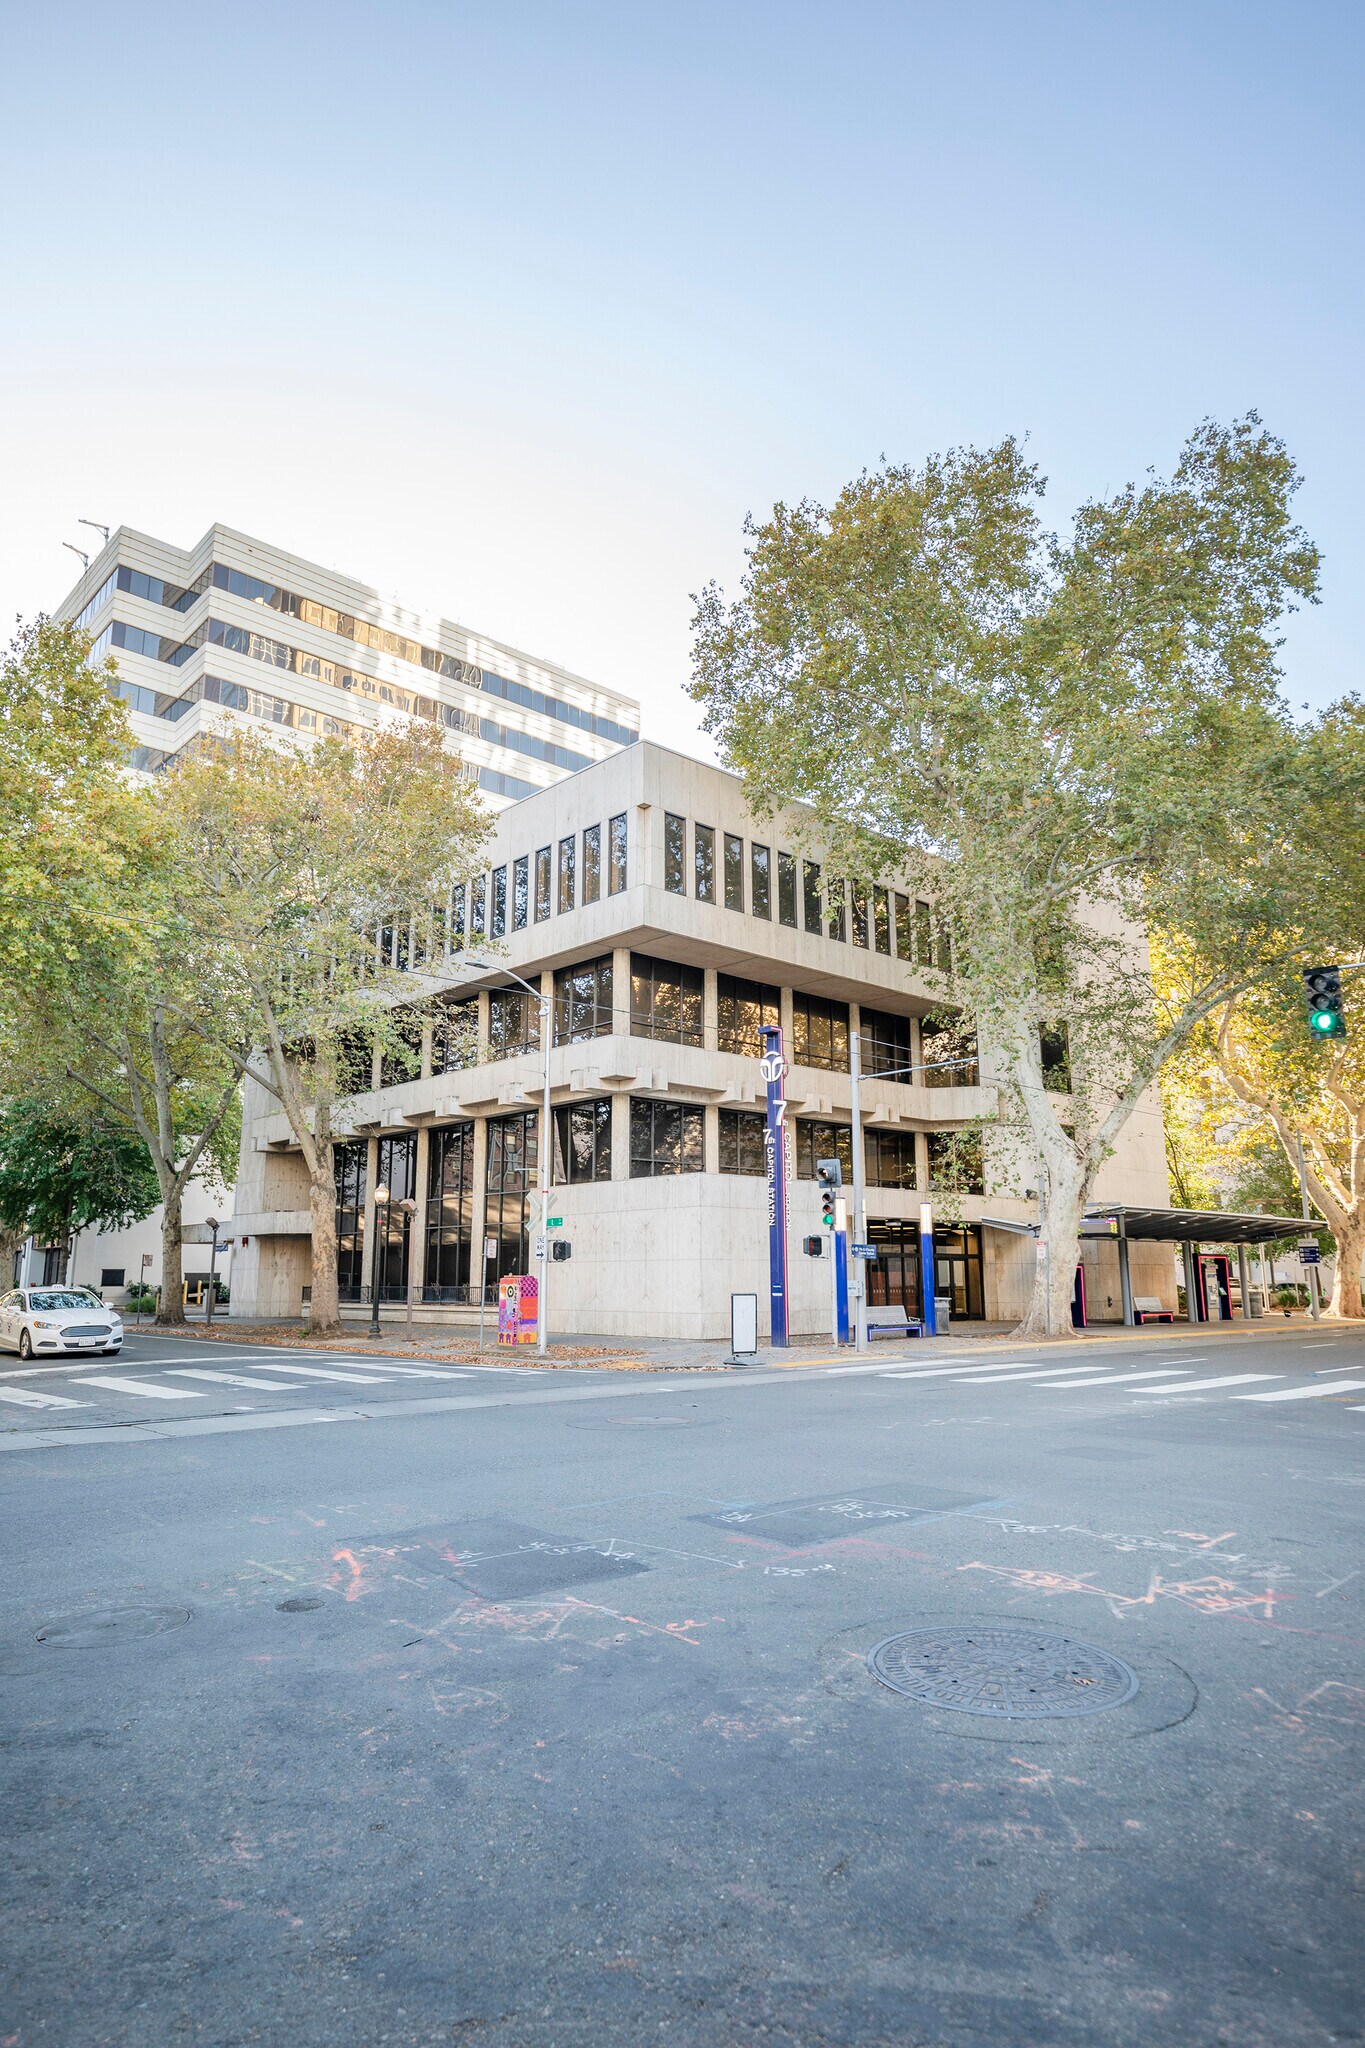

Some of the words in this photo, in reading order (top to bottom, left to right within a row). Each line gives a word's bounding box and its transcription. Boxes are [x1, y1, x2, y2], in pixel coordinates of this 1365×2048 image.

[762, 1128, 776, 1145] 7th
[766, 1147, 775, 1188] CAPITOL
[784, 1132, 793, 1187] CAPITOL
[767, 1188, 776, 1226] STATION
